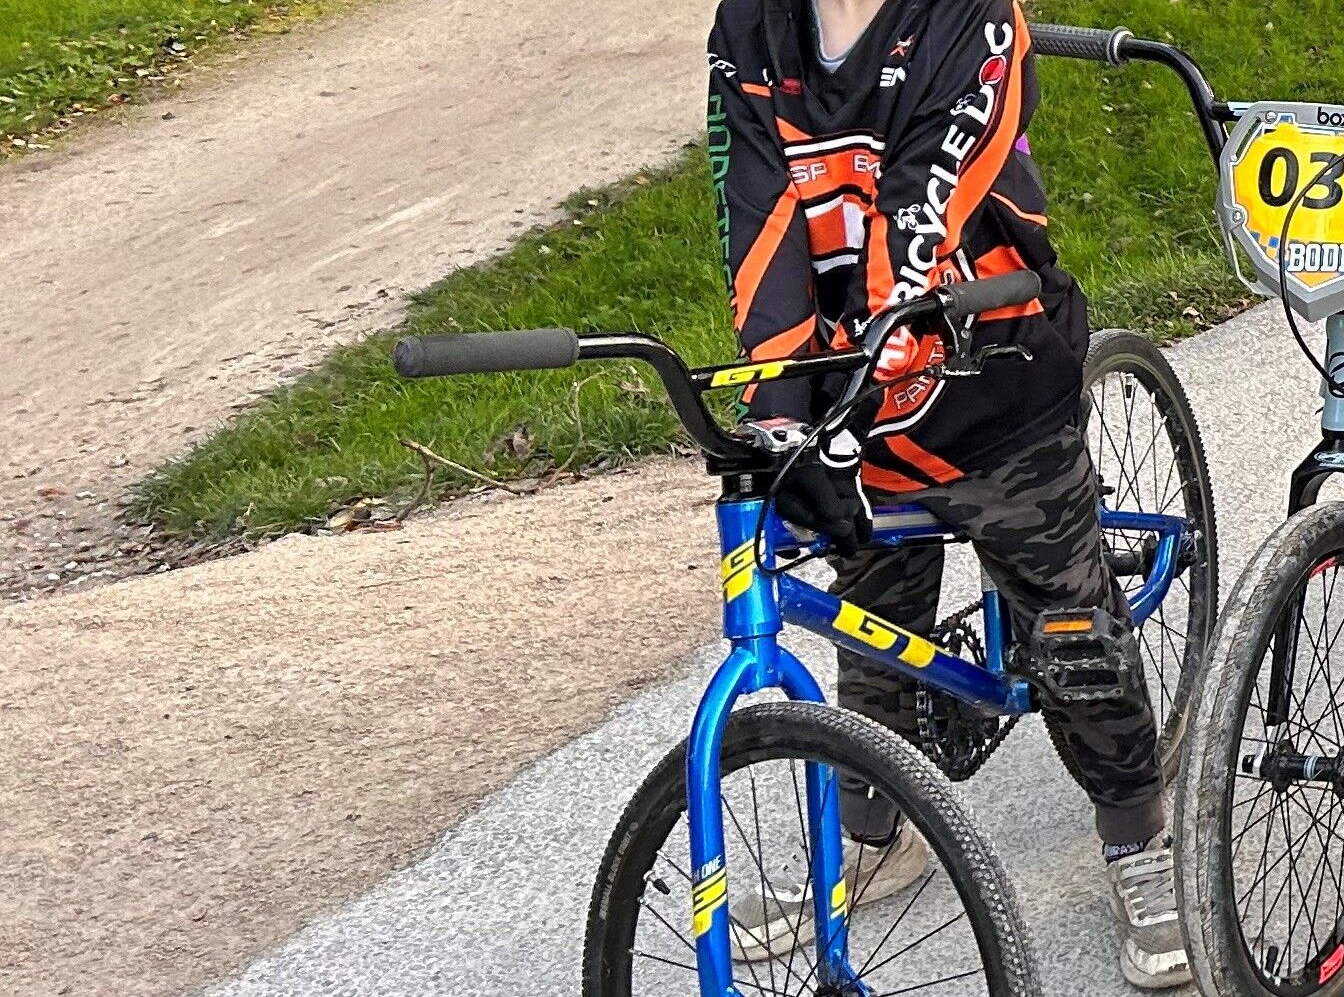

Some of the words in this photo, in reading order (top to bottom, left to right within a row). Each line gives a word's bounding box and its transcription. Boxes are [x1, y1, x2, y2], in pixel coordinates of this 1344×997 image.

[789, 162, 828, 184] SP
[885, 130, 975, 306] BICYCLE
[711, 360, 786, 387] GT
[832, 601, 955, 669] GT
